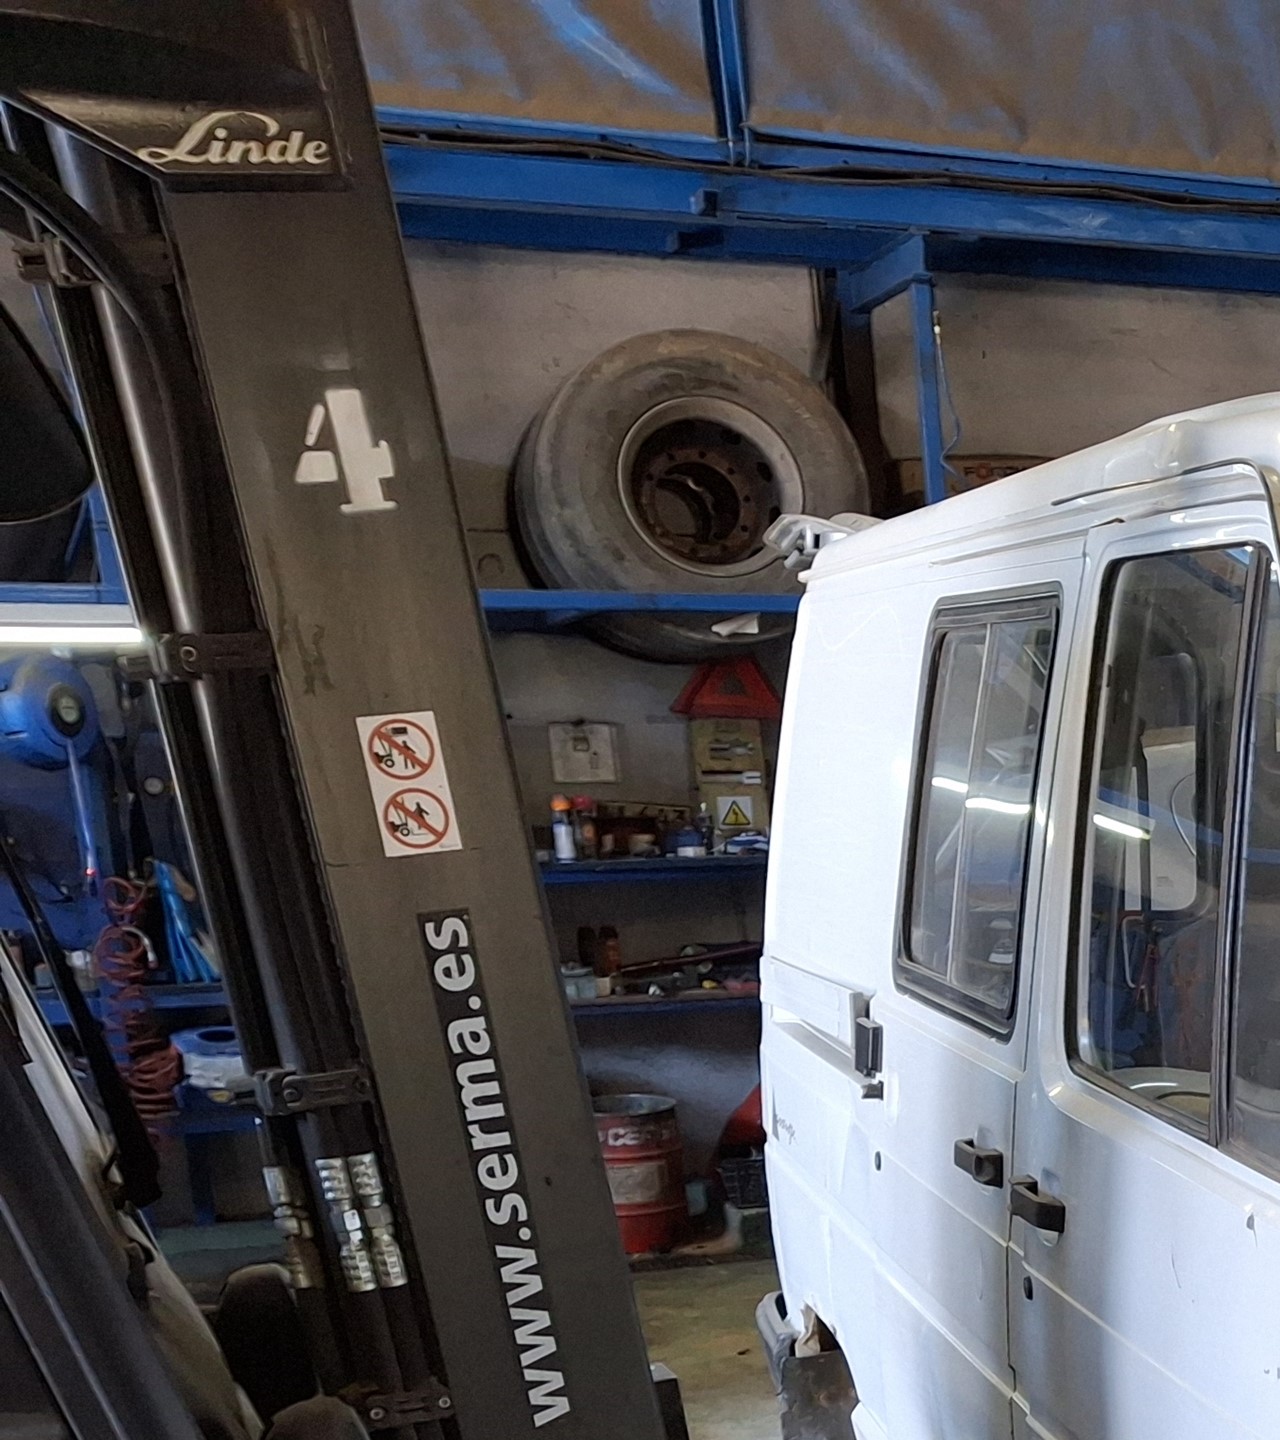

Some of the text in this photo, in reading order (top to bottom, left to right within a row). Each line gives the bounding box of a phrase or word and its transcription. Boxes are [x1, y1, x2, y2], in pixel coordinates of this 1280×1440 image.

[136, 110, 330, 165] Linde
[294, 388, 398, 515] 4
[424, 915, 571, 1429] www.serma.es
